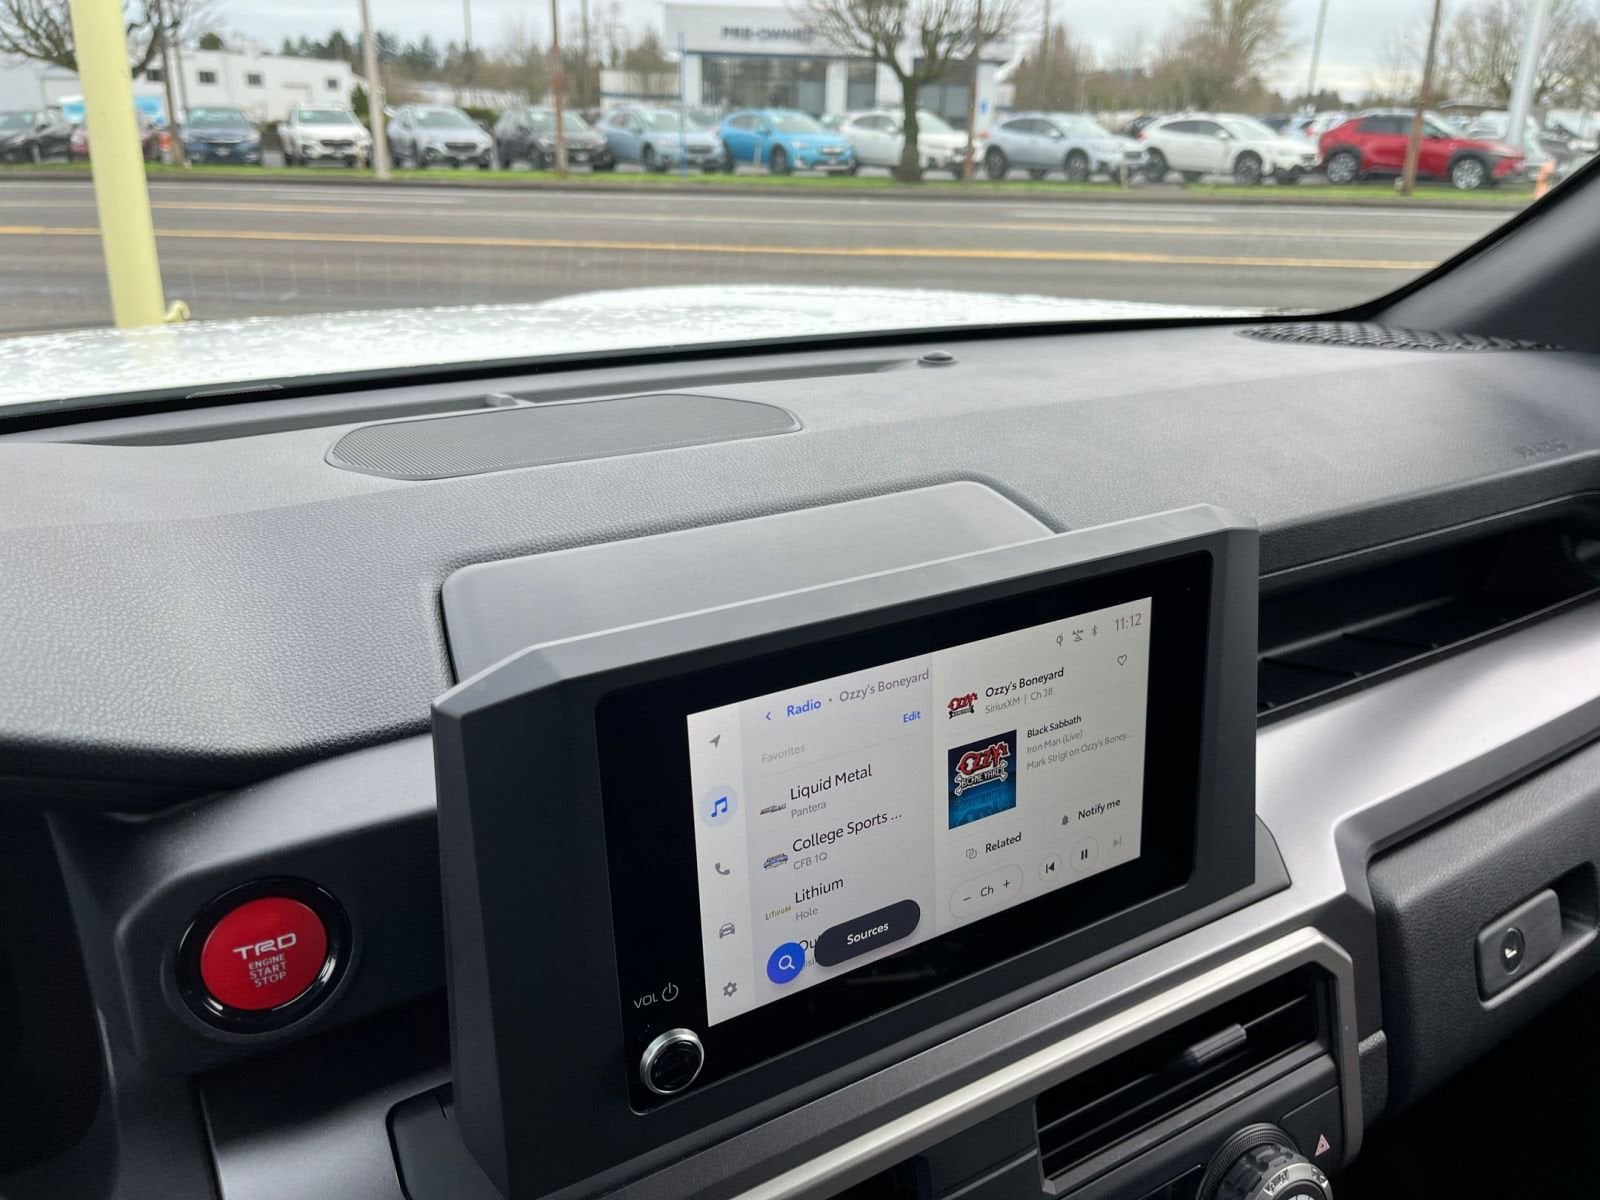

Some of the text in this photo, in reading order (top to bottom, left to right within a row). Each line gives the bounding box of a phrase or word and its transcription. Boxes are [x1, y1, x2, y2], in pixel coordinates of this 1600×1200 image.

[1115, 613, 1142, 631] 11:12
[786, 668, 930, 717] Radio Ozzy's Boneyard
[985, 666, 1064, 698] Ozzy's Boneyard
[985, 696, 1020, 714] SiriusXM
[1030, 691, 1042, 701] Ch
[1043, 687, 1053, 697] 38
[903, 710, 921, 724] Edit
[1027, 714, 1082, 738] Black Sabbath
[1026, 729, 1083, 755] Iron Man (Live)
[761, 743, 806, 764] Favorites
[1026, 757, 1046, 771] Mark
[1069, 748, 1080, 757] on
[1080, 740, 1103, 754] Ozzy's
[790, 764, 873, 800] Liquid Metal
[791, 800, 827, 819] Pantera
[1078, 799, 1121, 821] Notify me
[792, 826, 844, 852] College
[847, 812, 888, 836] Sports
[985, 832, 1022, 853] Related
[793, 857, 812, 871] CFB
[814, 851, 828, 865] 1Q
[794, 878, 844, 904] Lithium
[980, 885, 994, 898] Ch
[795, 906, 819, 921] Hole
[847, 921, 889, 945] Sources
[232, 932, 297, 960] TRD
[248, 953, 286, 970] ENGINE
[249, 961, 287, 980] START
[255, 971, 287, 988] STOP
[633, 993, 659, 1009] VOL
